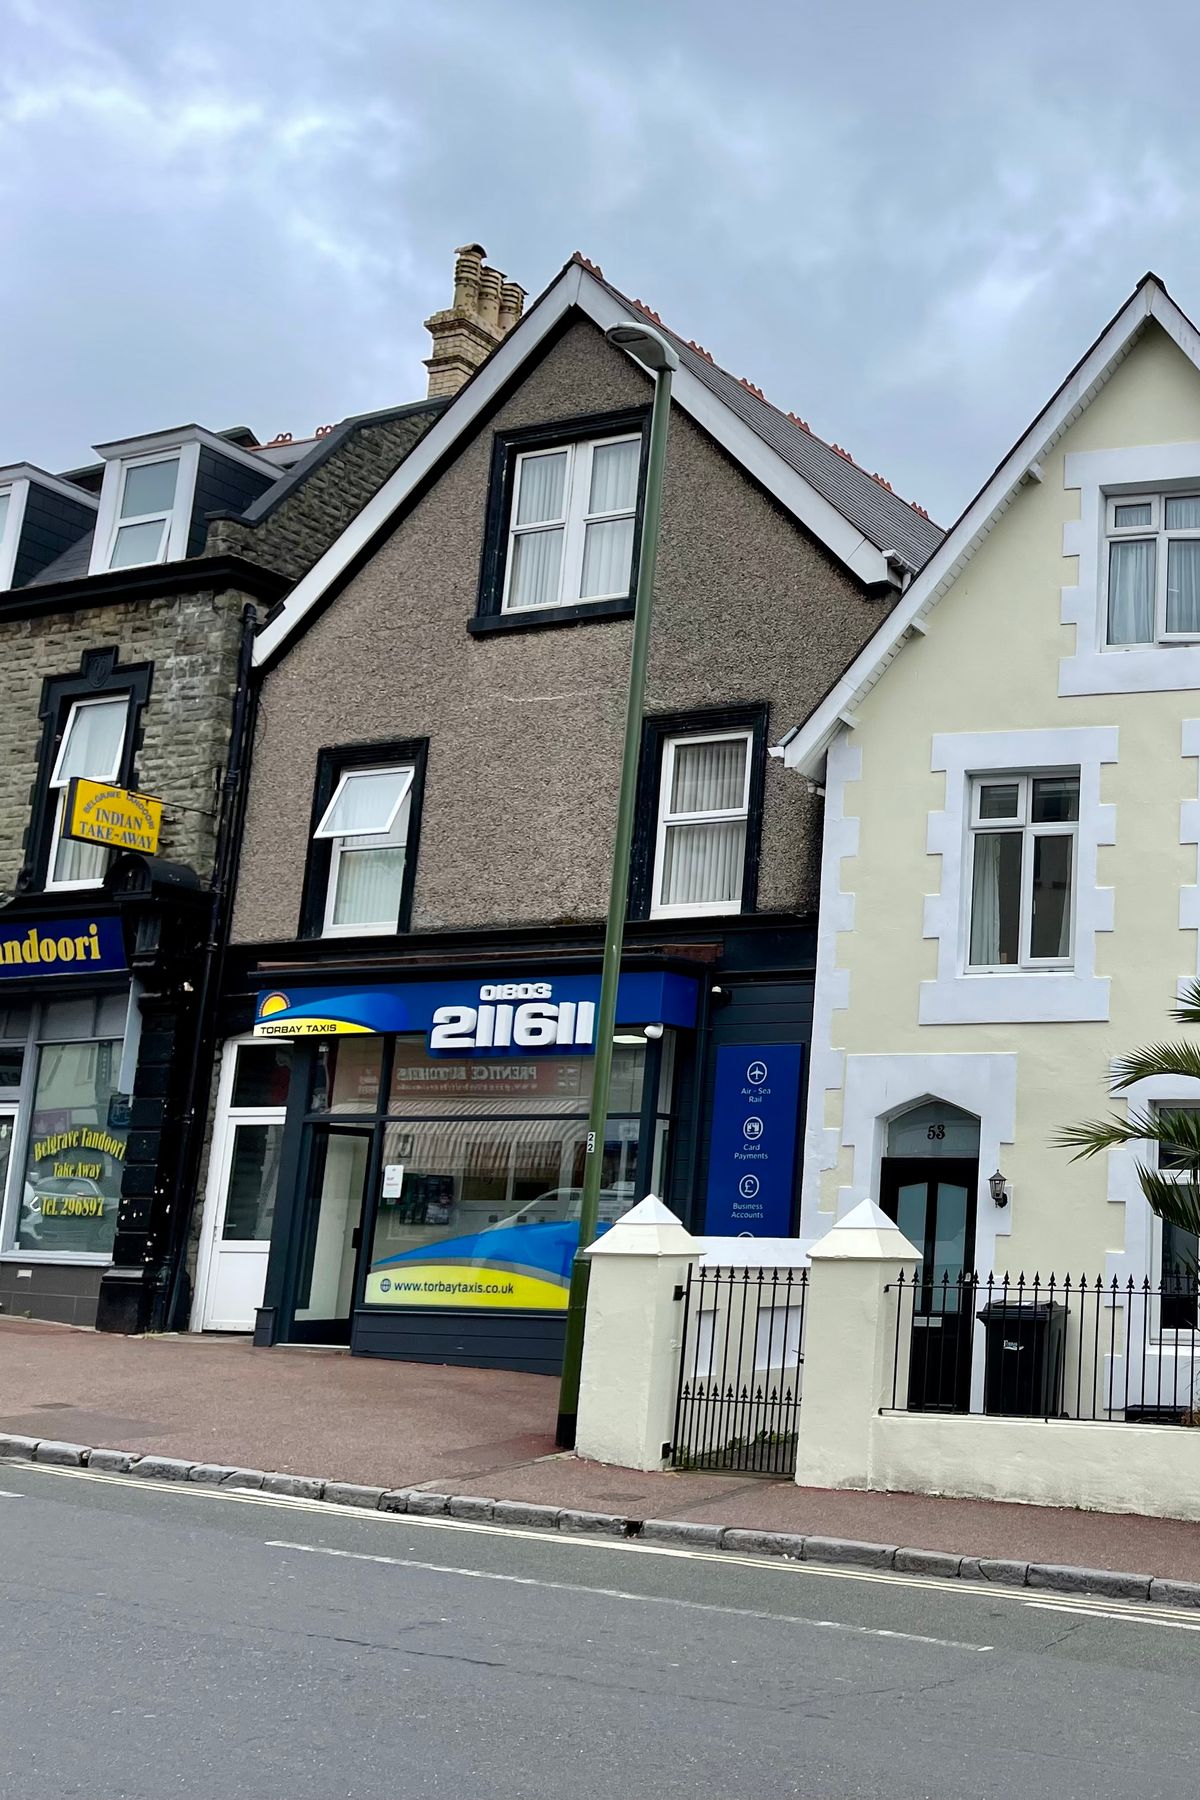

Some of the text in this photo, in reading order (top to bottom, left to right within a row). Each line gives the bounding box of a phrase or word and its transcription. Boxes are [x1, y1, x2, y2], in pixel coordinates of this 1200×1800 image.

[95, 807, 142, 830] INDIAN
[79, 821, 153, 849] TAKE-AWAY
[480, 983, 552, 1001] 01803
[260, 1024, 337, 1034] TORBAY TAXIS
[430, 1002, 596, 1049] 211611
[758, 1087, 771, 1095] Sea
[927, 1124, 945, 1140] 53
[34, 1127, 126, 1162] Belgrave Tandoori
[743, 1143, 761, 1151] Card
[734, 1152, 768, 1160] Payments
[53, 1162, 102, 1180] Take Away
[60, 1195, 105, 1216] 296897
[731, 1211, 764, 1219] Accounts
[394, 1280, 514, 1295] www.torbaytaxis.co.uk
